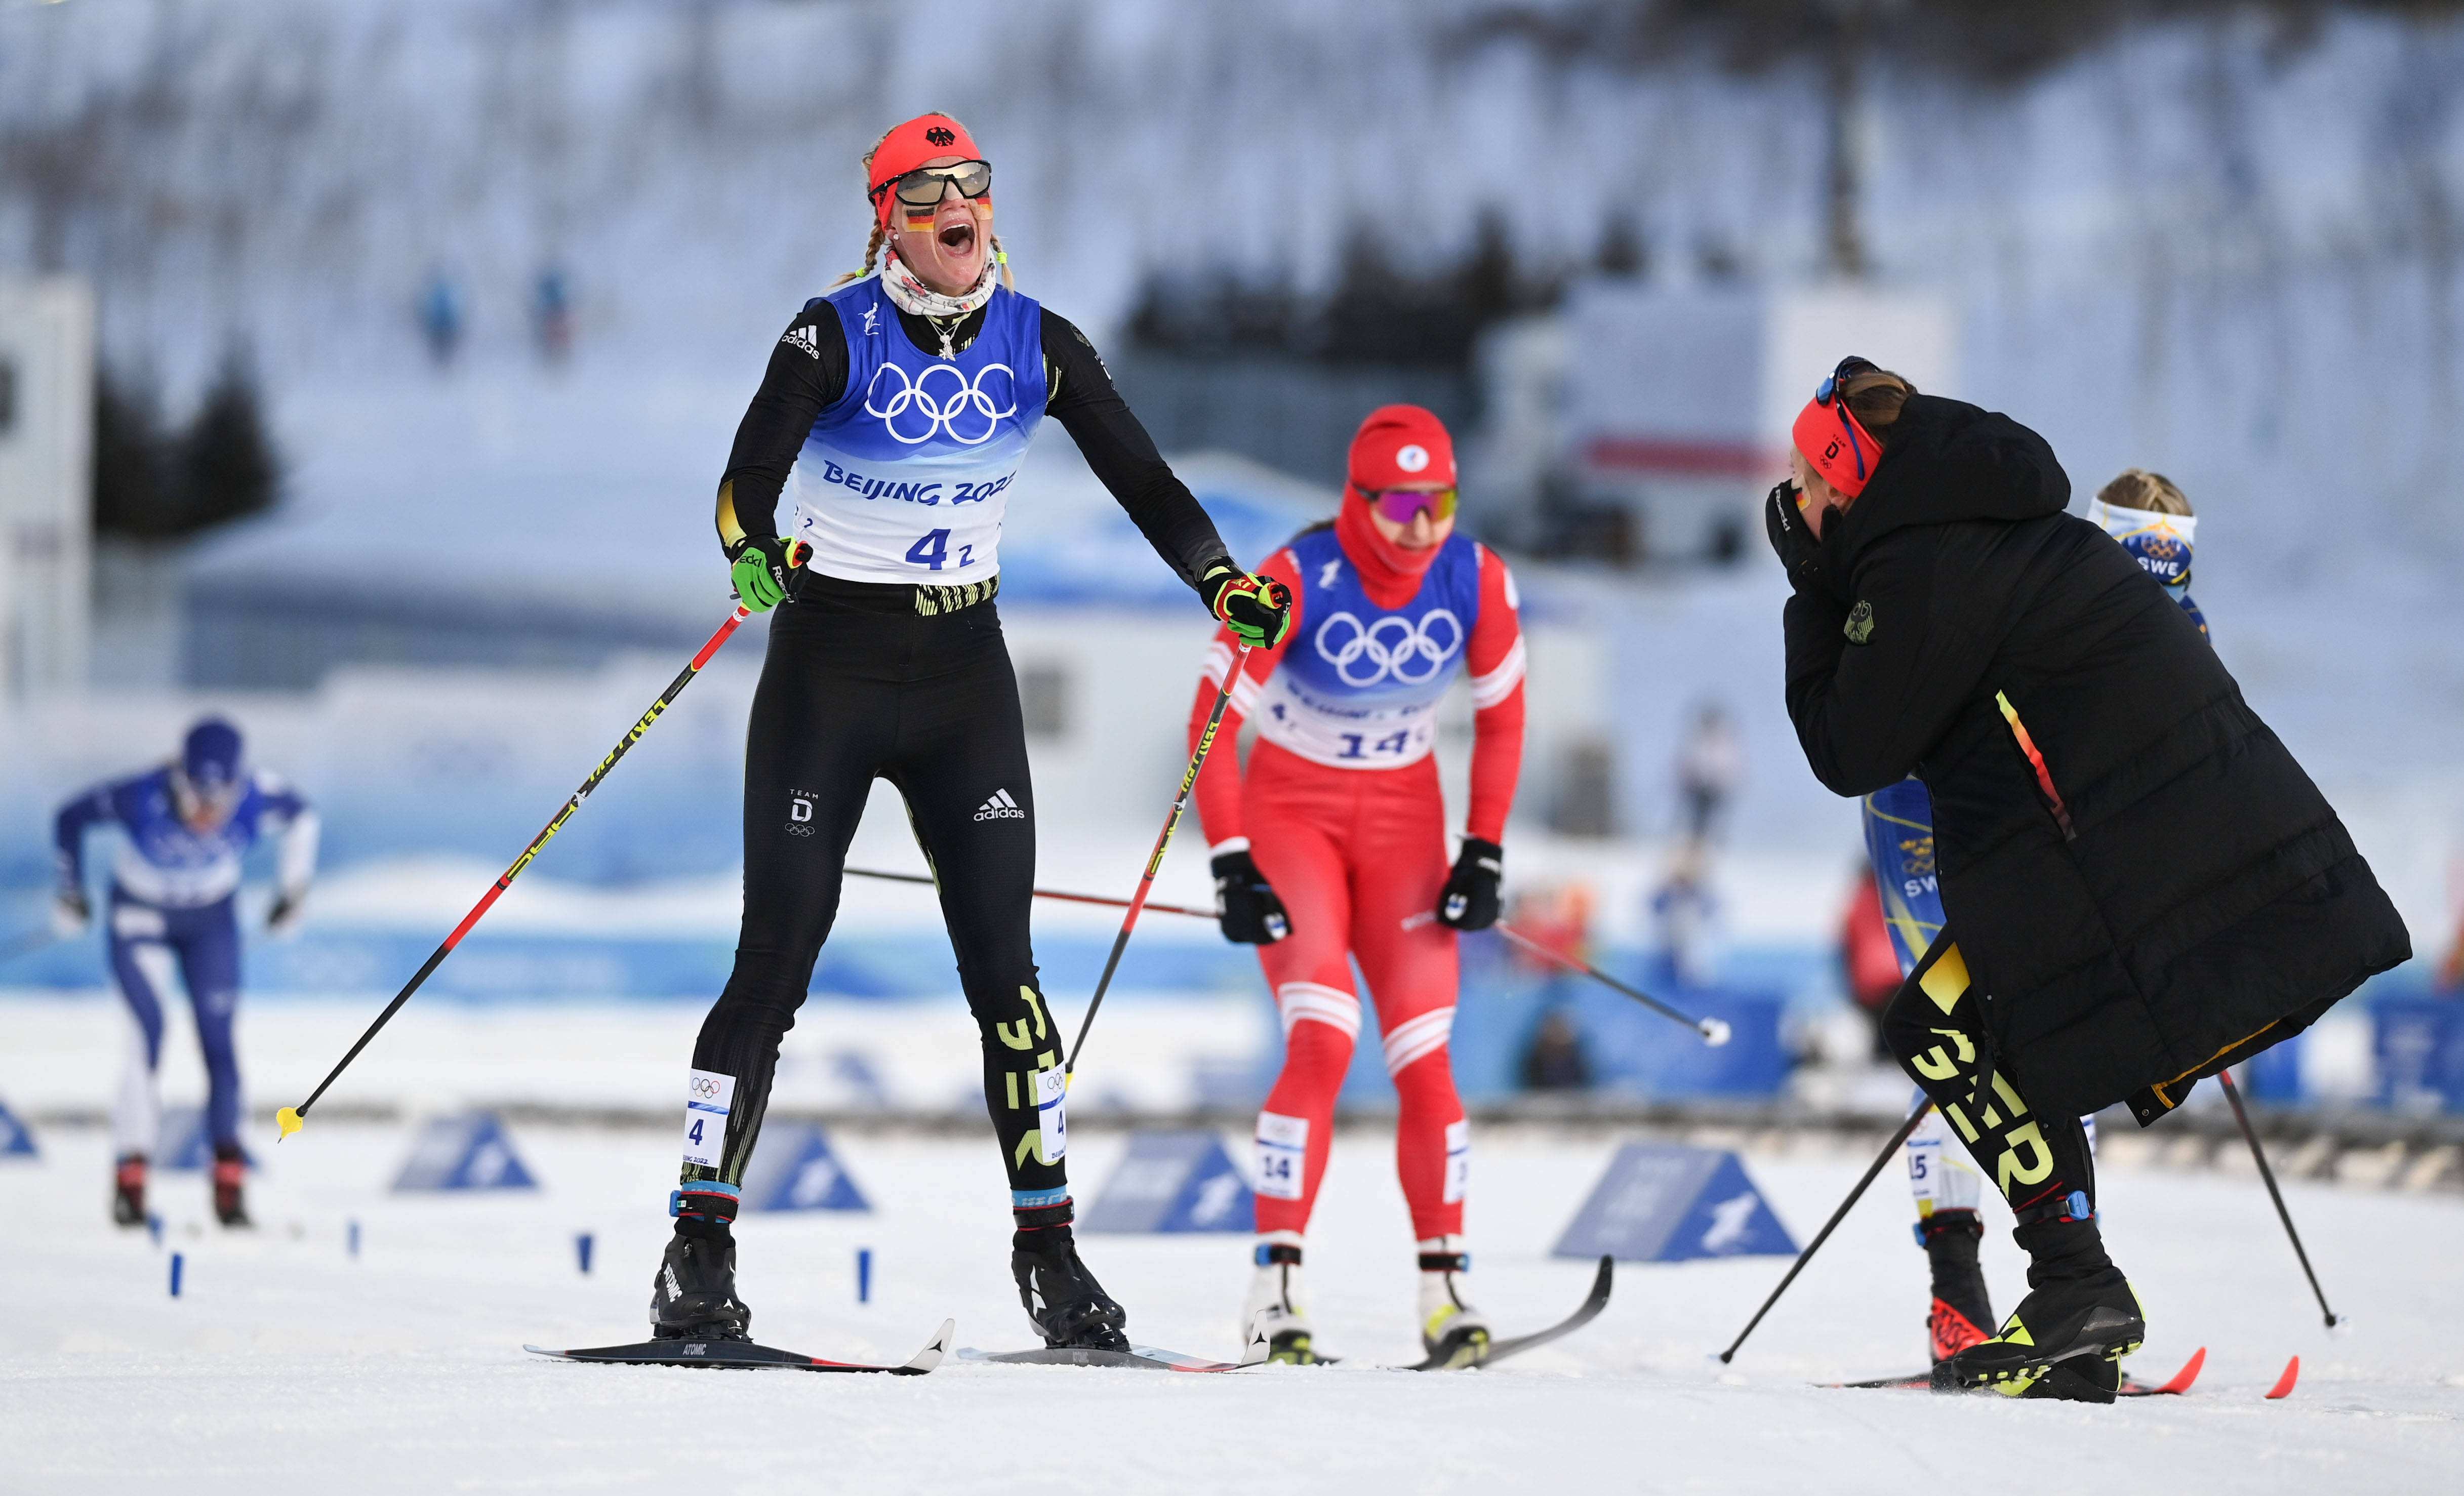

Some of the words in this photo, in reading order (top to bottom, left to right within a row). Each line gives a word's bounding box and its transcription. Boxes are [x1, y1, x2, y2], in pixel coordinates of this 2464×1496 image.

[781, 335, 820, 359] adidas
[823, 460, 942, 505] BEIJING
[905, 529, 951, 571] 4
[959, 544, 975, 568] 2
[2137, 557, 2179, 576] SWE
[629, 699, 668, 741] LEKI
[1199, 721, 1219, 755] LEKI
[1338, 730, 1408, 758] 14
[790, 789, 819, 799] TEAM
[791, 798, 812, 822] D
[974, 808, 1025, 822] adidas
[1911, 1028, 2054, 1200] GER
[689, 1119, 704, 1146] 4
[664, 1263, 682, 1303] ATOMIC
[682, 1343, 707, 1355] ATOMIC
